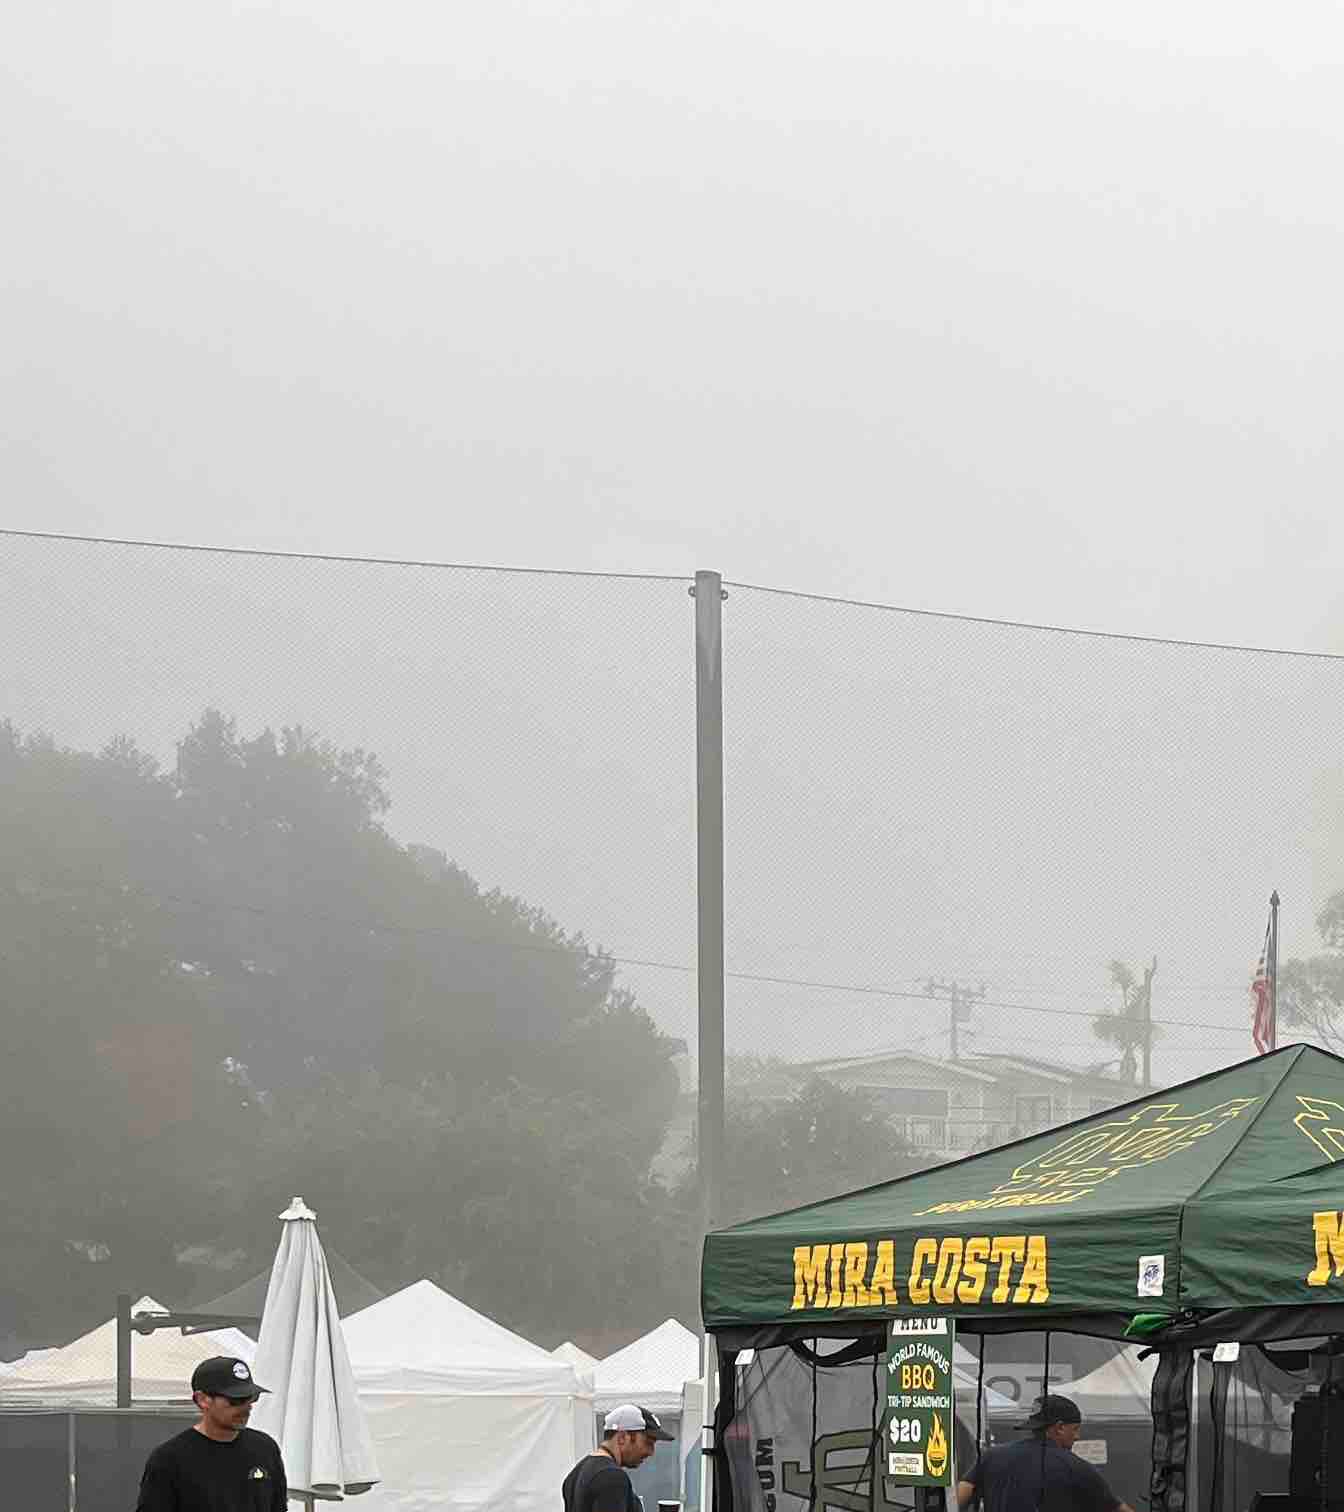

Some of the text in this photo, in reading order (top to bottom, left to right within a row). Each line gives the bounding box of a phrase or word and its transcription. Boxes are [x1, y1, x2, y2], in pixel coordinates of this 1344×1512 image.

[791, 1235, 1051, 1310] MIRA COSTA
[900, 1318, 938, 1330] MENU
[888, 1343, 950, 1375] WORLD FAMOUS
[902, 1364, 935, 1390] BBQ
[888, 1395, 950, 1409] TRI-TIP SANDWICH
[890, 1416, 921, 1444] $20
